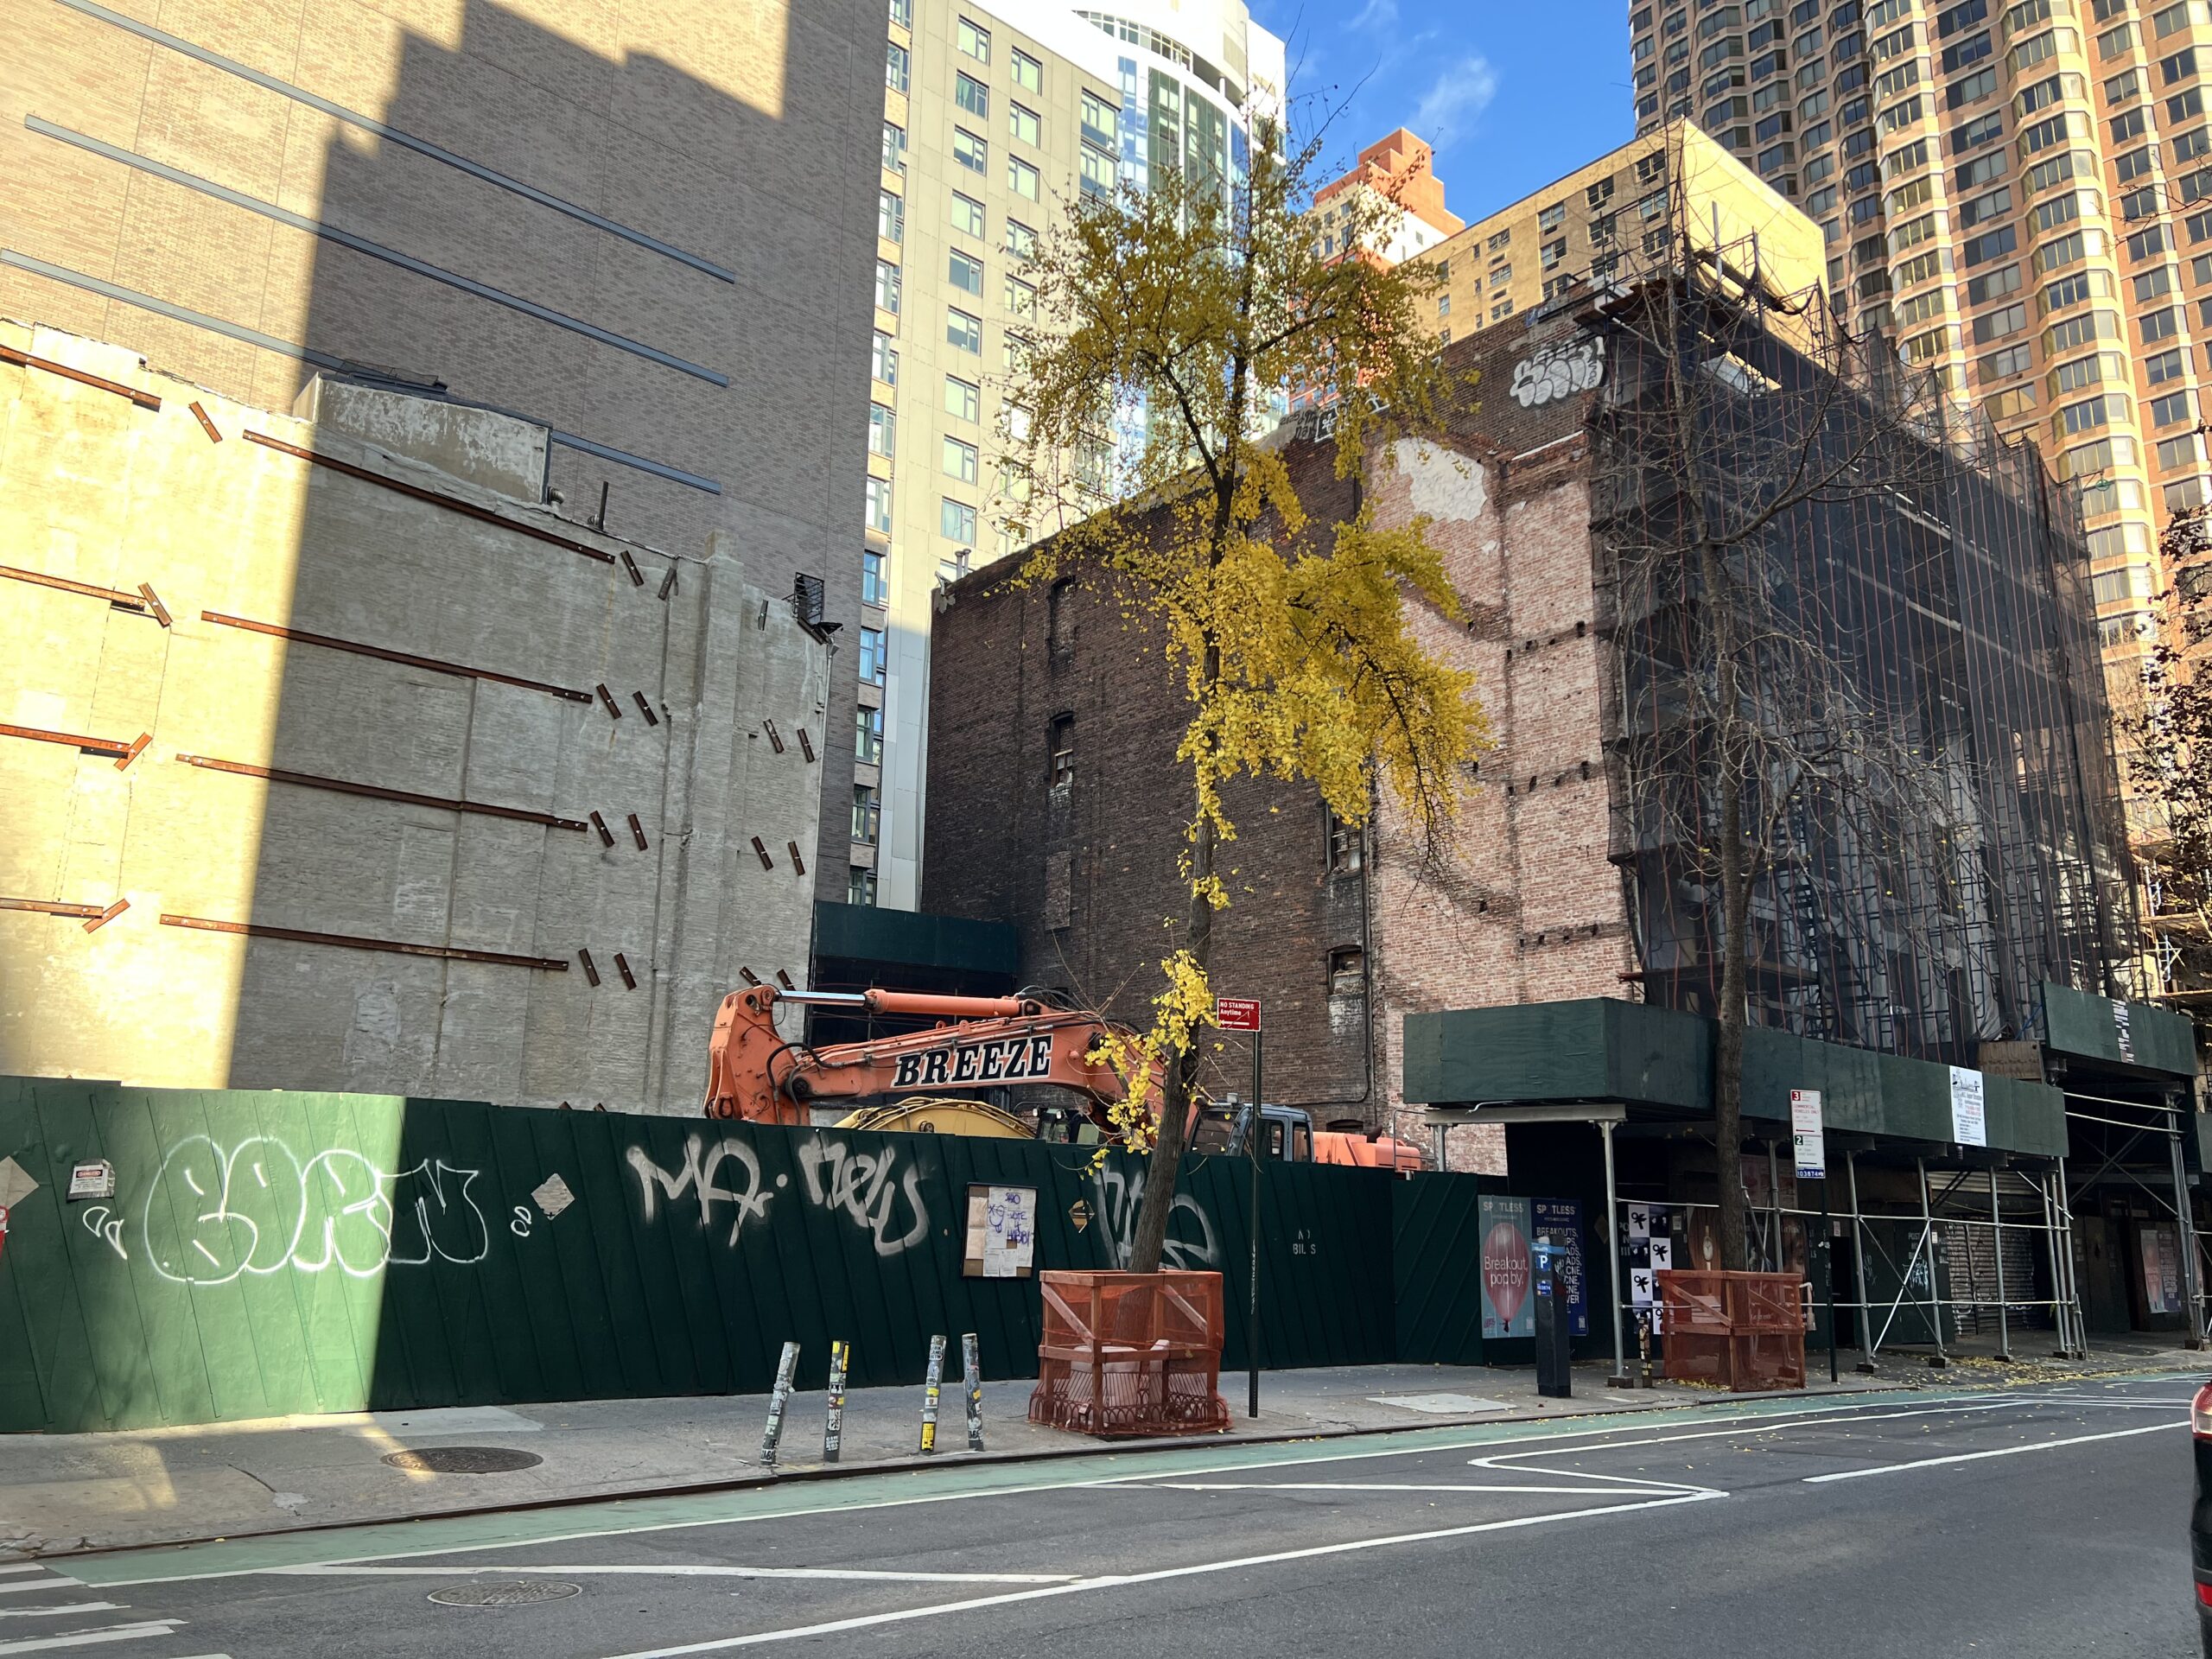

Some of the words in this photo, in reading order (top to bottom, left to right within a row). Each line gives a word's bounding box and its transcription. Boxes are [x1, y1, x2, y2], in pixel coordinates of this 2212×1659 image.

[892, 1034, 1052, 1087] BREEZE
[1796, 1136, 1802, 1145] 2
[1293, 1243, 1316, 1255] BILS
[1484, 1256, 1529, 1272] Breakout,
[1540, 1255, 1548, 1268] P
[1491, 1273, 1509, 1287] pop
[1510, 1273, 1524, 1287] by.
